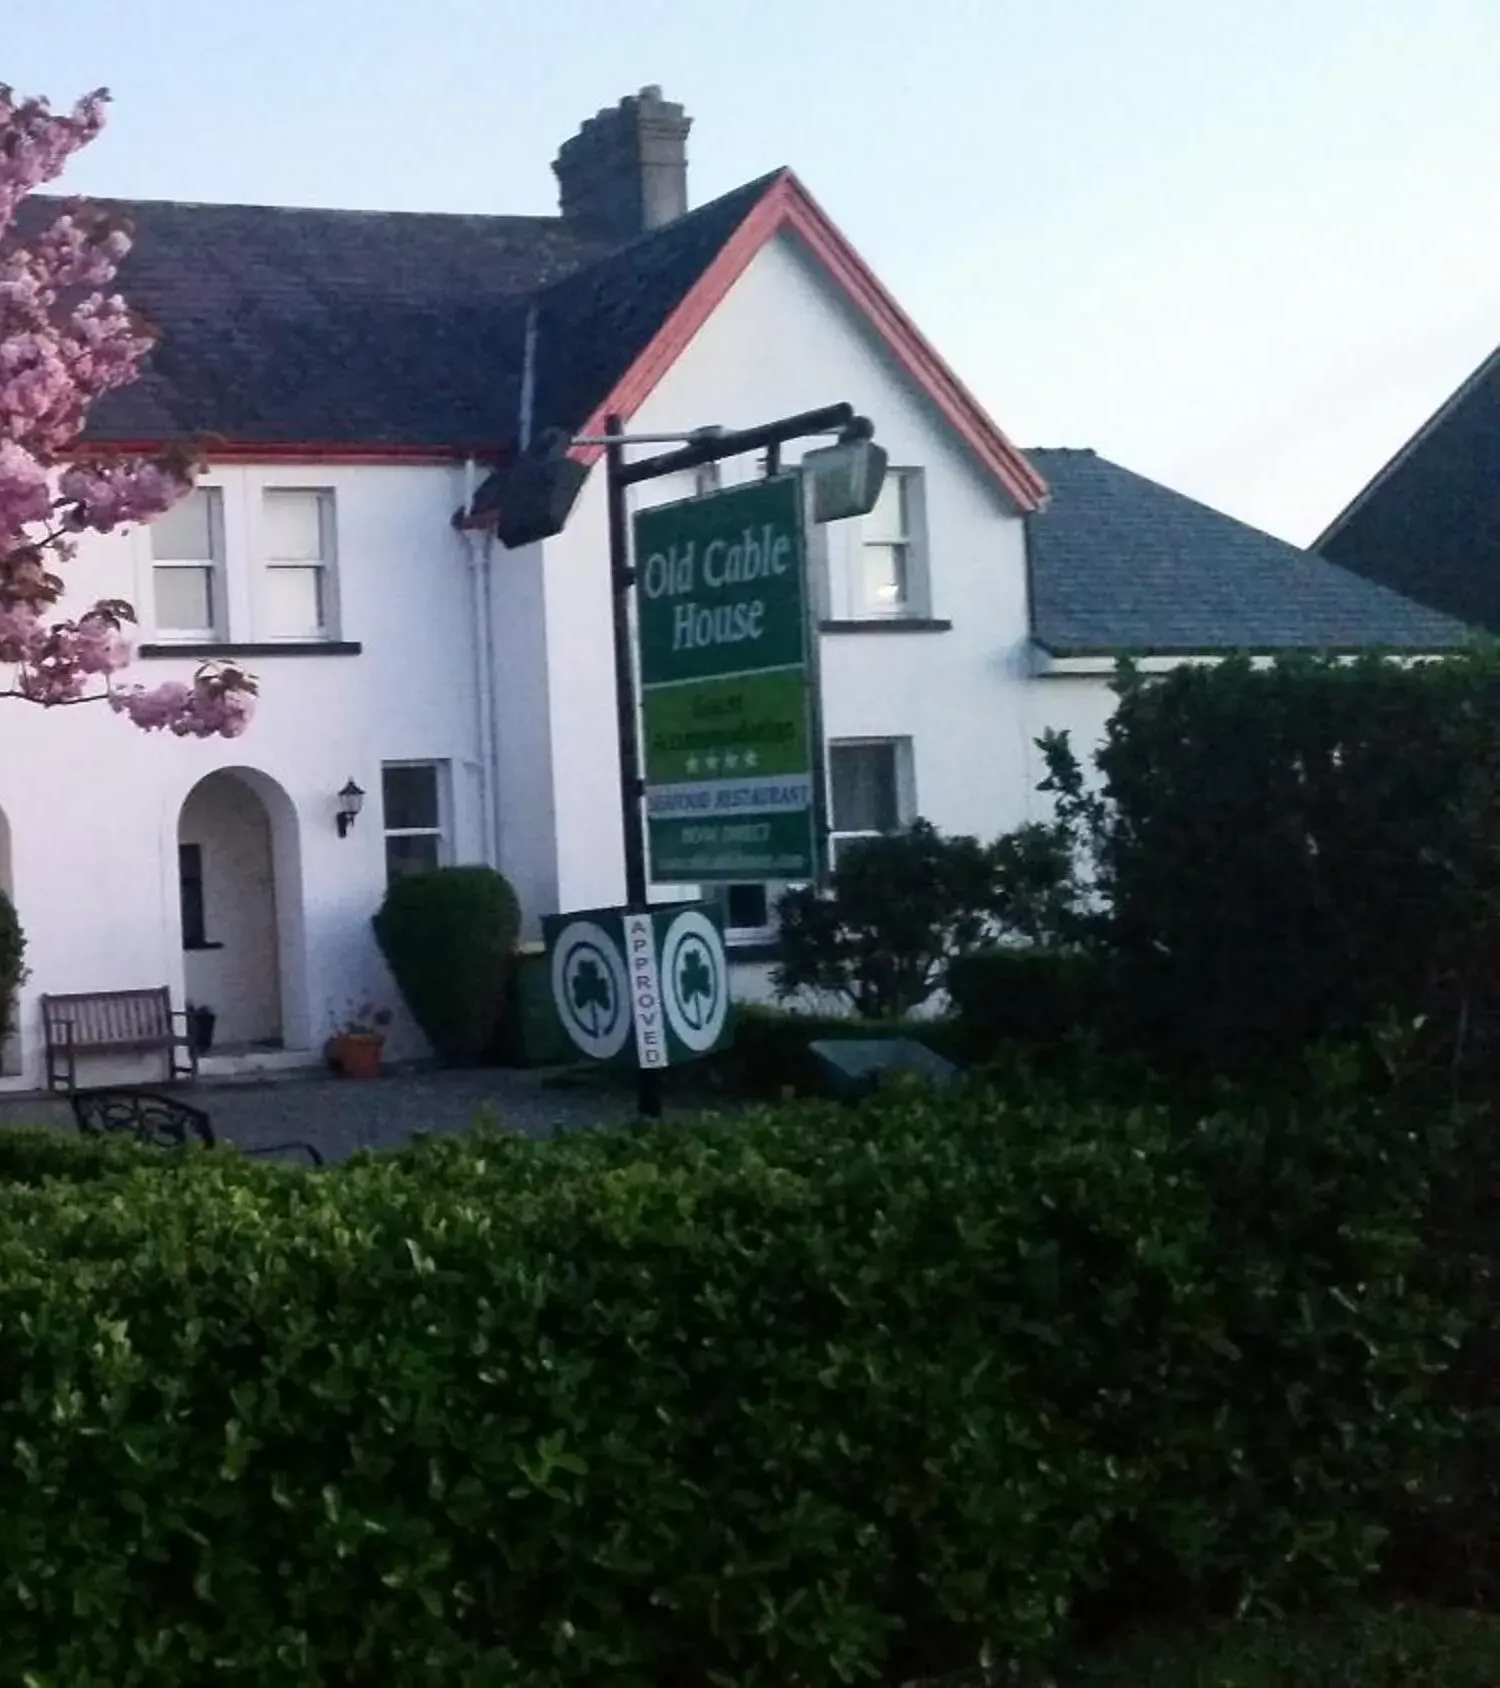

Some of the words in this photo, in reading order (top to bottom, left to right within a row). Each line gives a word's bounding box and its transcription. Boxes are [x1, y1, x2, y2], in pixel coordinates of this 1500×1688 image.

[644, 540, 696, 598] Old
[703, 523, 791, 587] Cable
[672, 600, 765, 651] House
[631, 920, 660, 1063] APPROVED
